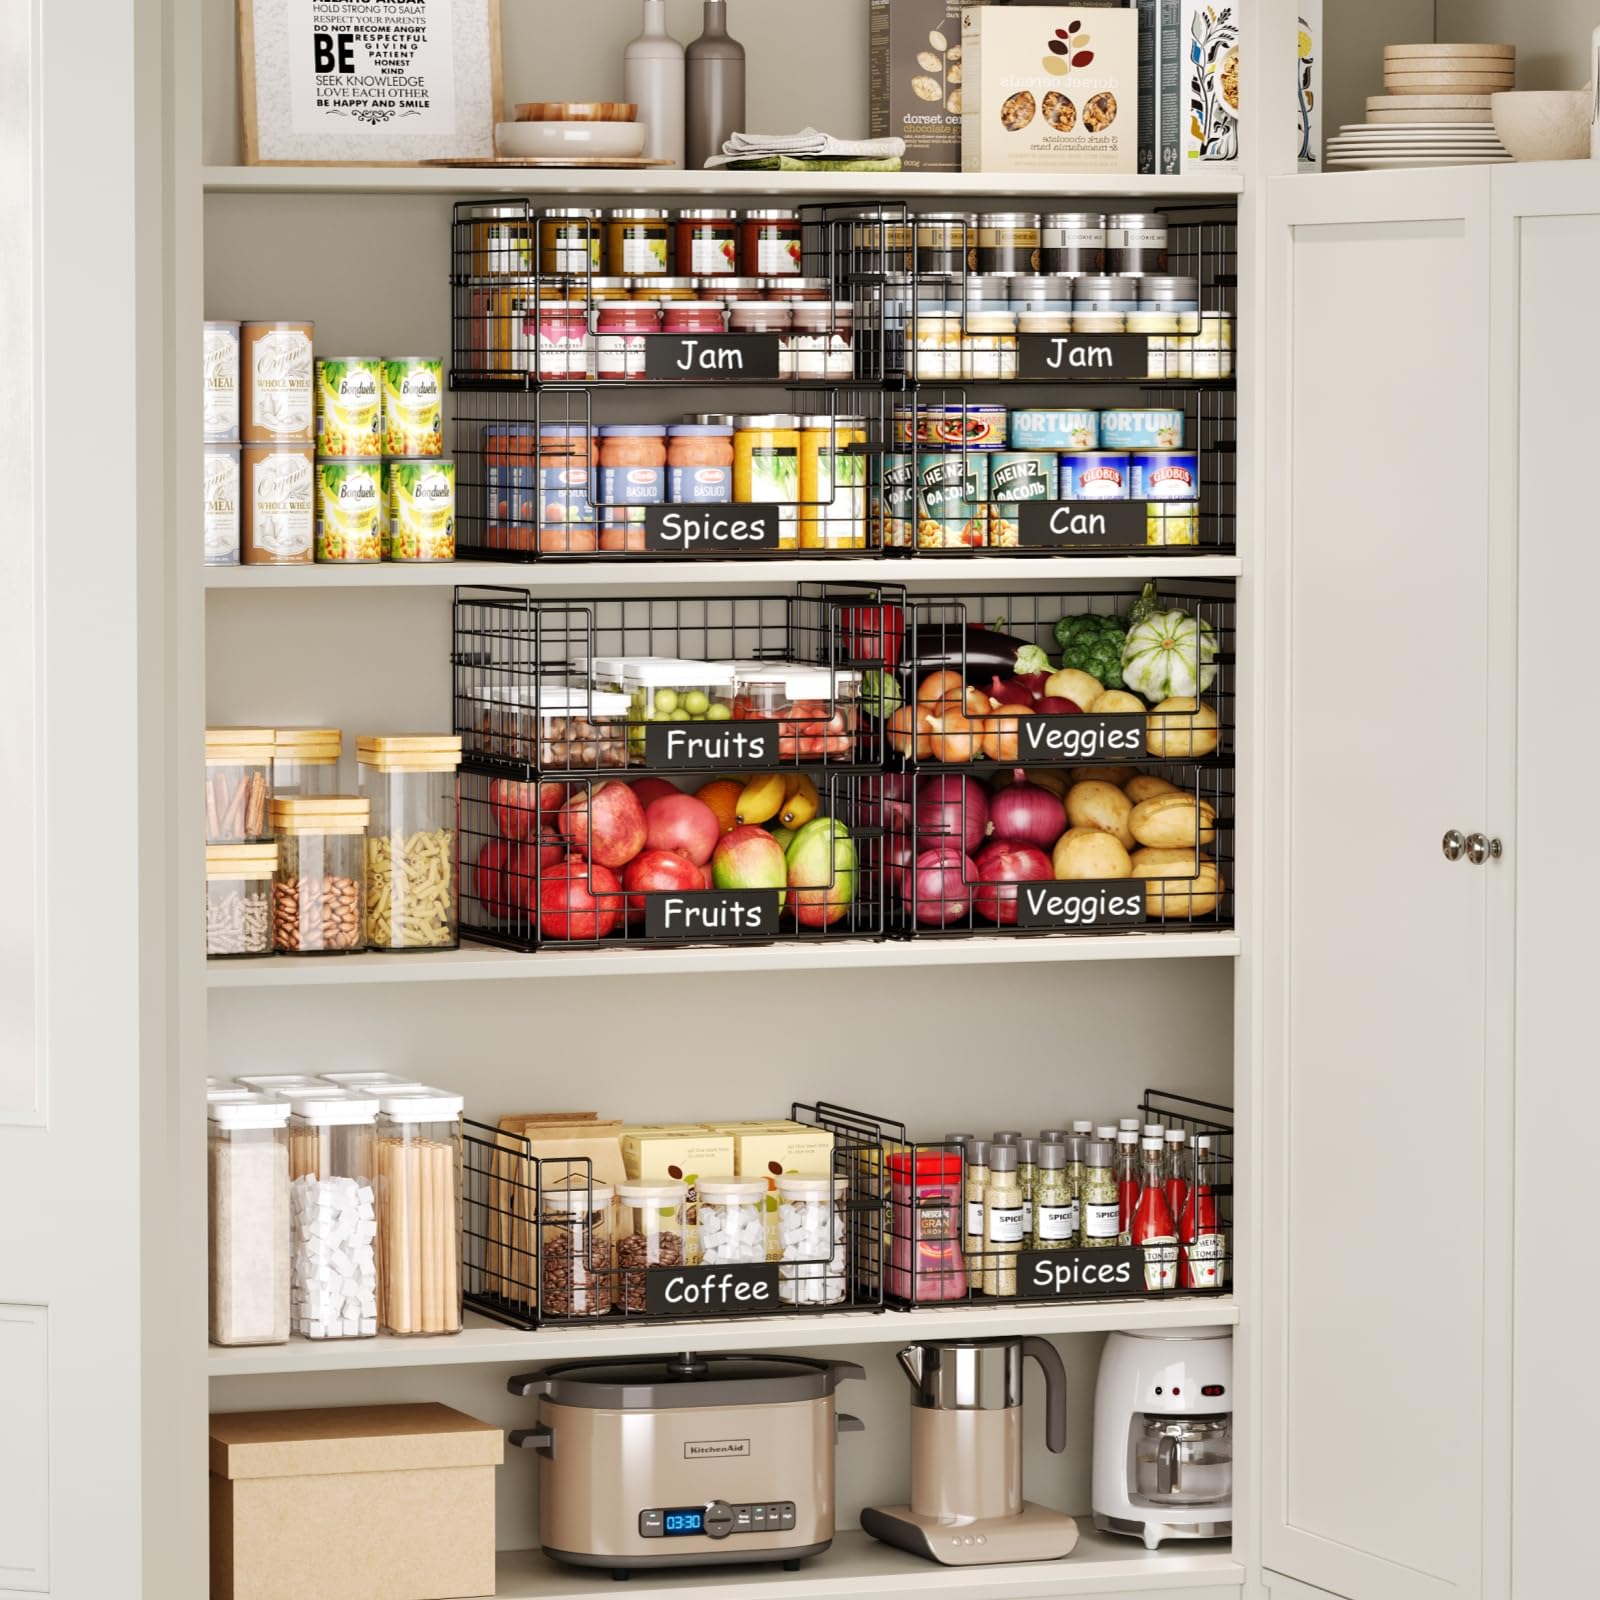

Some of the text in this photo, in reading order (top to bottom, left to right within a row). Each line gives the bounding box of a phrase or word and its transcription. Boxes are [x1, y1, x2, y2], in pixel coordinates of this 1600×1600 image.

[313, 4, 426, 14] HOLD STRONG TO SALAT
[313, 15, 426, 25] RESPECT YOUR PARENTS
[354, 25, 391, 33] BECOME
[355, 34, 428, 42] RESPECTFUL
[314, 33, 355, 73] BE
[315, 75, 425, 87] SEEK KNOWLEDGE
[316, 87, 430, 98] LOVE EACH OTHER
[316, 99, 329, 107] BE
[333, 99, 368, 107] HAPPY
[399, 100, 430, 108] SMILE
[903, 113, 943, 124] dorset
[903, 124, 951, 133] chocolate
[677, 340, 743, 370] Jam
[1046, 338, 1113, 369] Jam
[341, 381, 376, 398] Bonduelle
[402, 381, 437, 397] Bonduelle
[1013, 412, 1095, 433] FORTUNA
[1101, 412, 1181, 432] FORTUNA
[997, 463, 1037, 486] HEINZ
[1083, 468, 1121, 483] GLOBUS
[1153, 468, 1190, 483] GLOBUS
[340, 484, 375, 501] Bonduelle
[415, 484, 450, 501] Bonduelle
[626, 486, 657, 497] BASILICO
[694, 486, 725, 497] BASILICO
[997, 482, 1045, 501] ФАСОЛЬ
[1049, 506, 1106, 535] Can
[660, 513, 765, 549] Spices
[667, 729, 765, 760] Fruits
[1026, 722, 1140, 757] Veggies
[664, 898, 762, 928] Fruits
[1026, 889, 1141, 924] Veggies
[1033, 1258, 1130, 1292] Spices
[664, 1273, 769, 1304] Coffee
[690, 1443, 744, 1455] KitchenAid
[666, 1514, 700, 1530] 03:30
